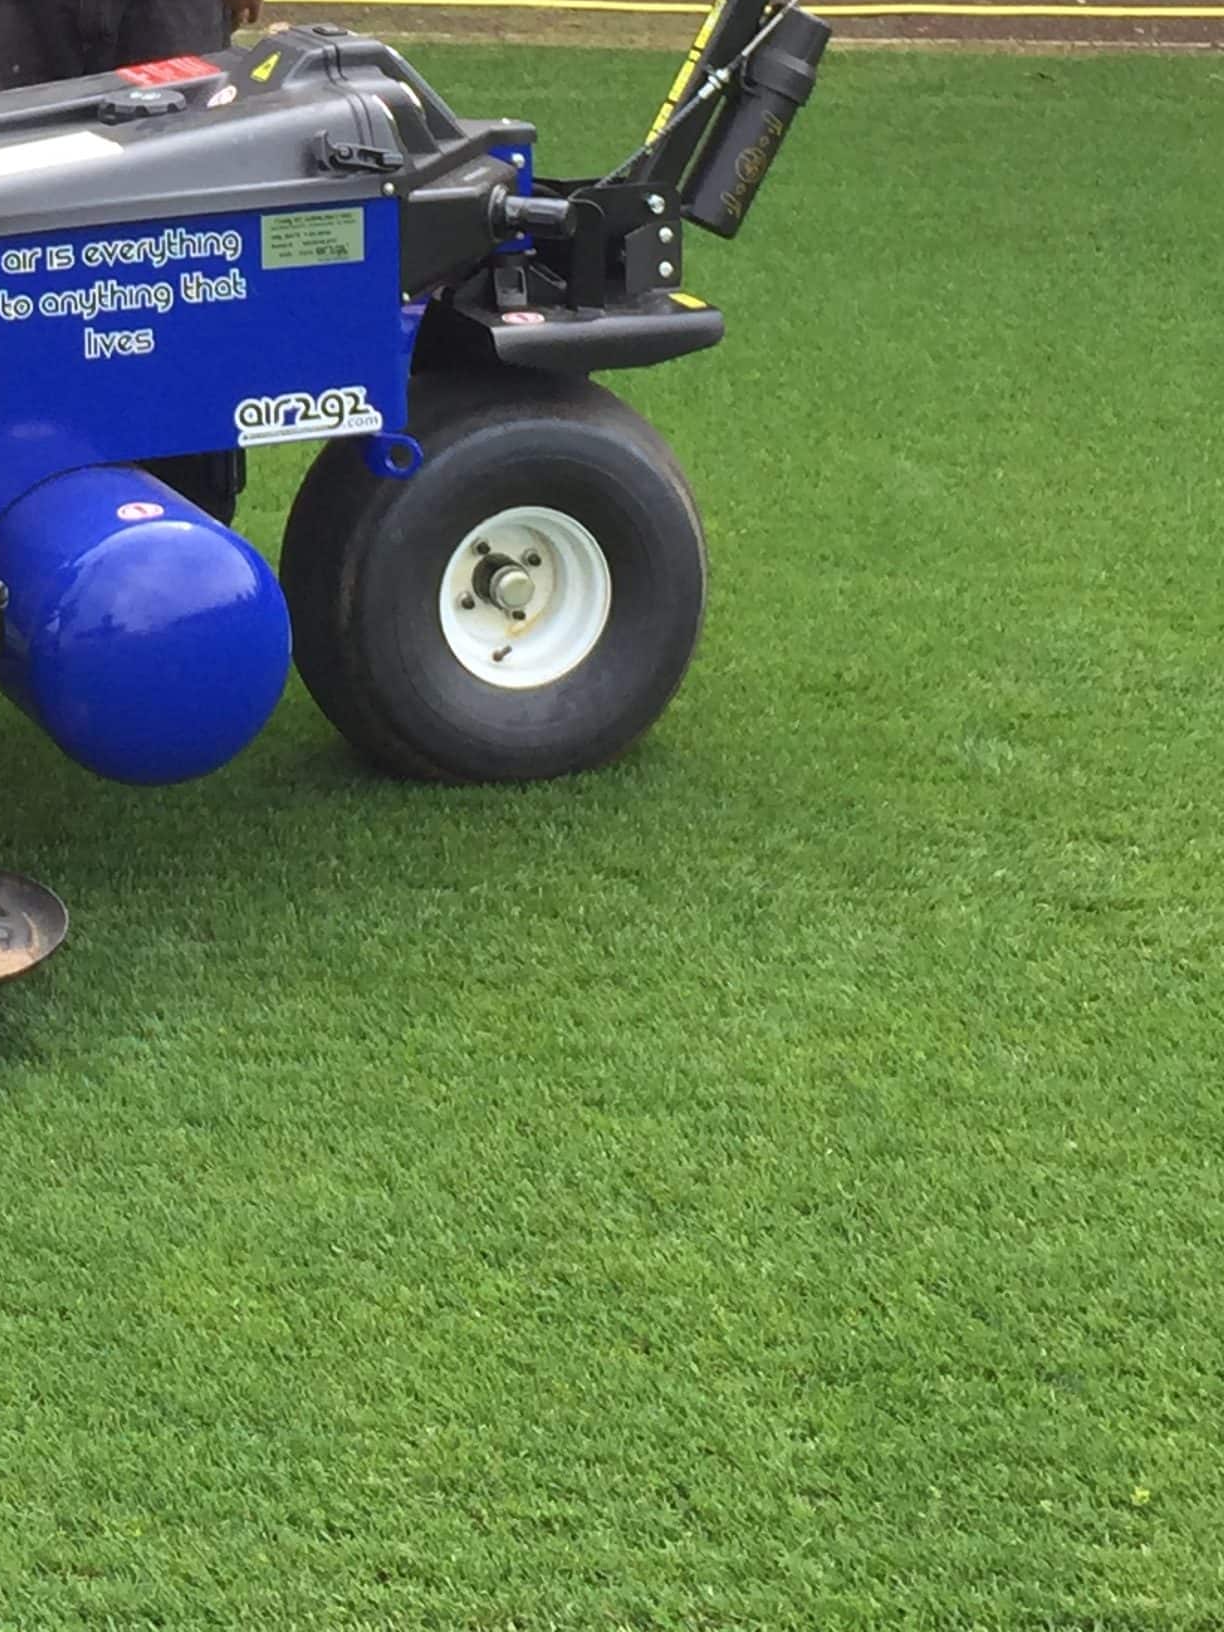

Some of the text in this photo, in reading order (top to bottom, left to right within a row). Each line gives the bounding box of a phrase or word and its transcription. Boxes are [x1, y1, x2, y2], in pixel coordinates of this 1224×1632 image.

[2, 229, 241, 273] air is everything
[39, 280, 173, 320] anything
[181, 269, 247, 303] that
[85, 328, 154, 358] lives
